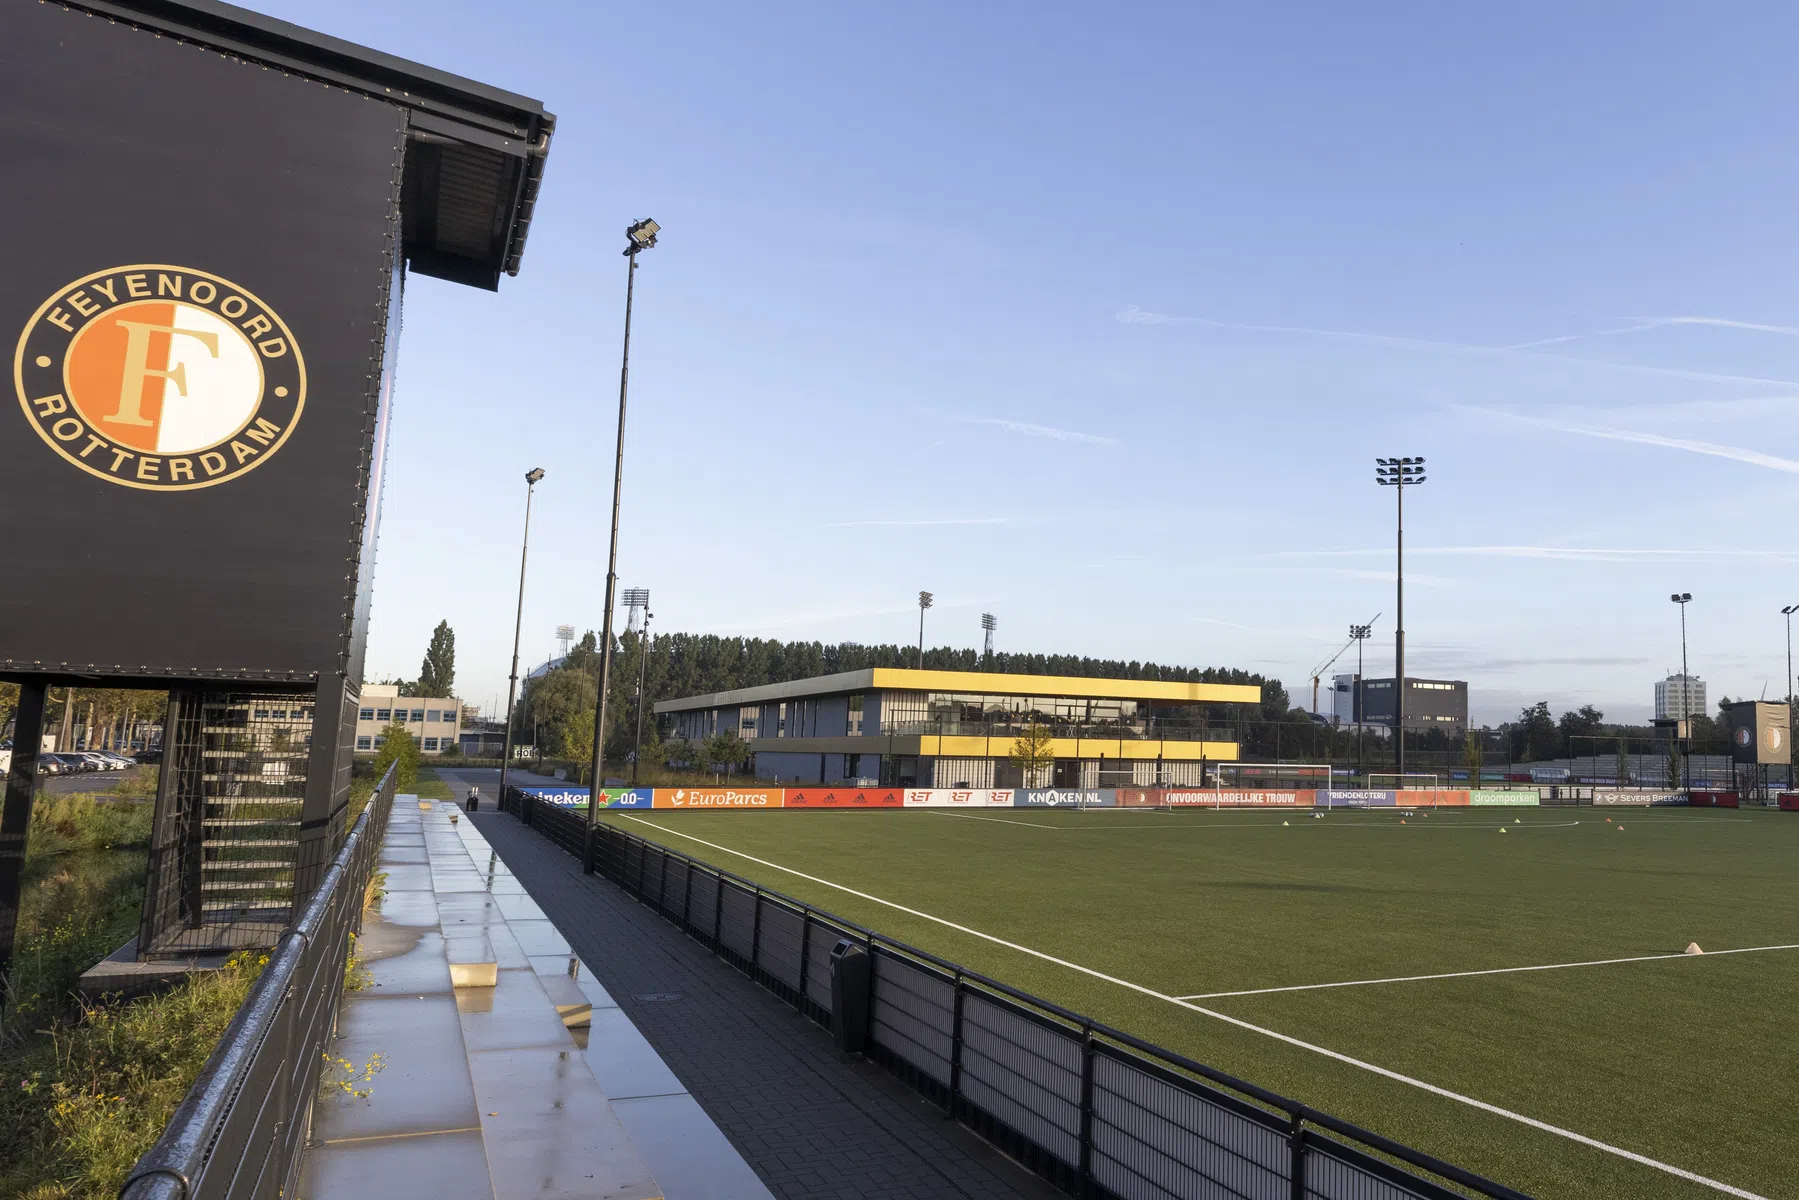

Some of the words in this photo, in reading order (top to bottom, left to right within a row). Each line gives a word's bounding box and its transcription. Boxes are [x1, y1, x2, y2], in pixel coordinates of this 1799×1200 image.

[46, 273, 287, 359] FEYENOORD
[103, 319, 219, 427] F
[34, 393, 282, 481] ROTTERDAM
[689, 791, 768, 805] EuroParcs
[910, 791, 933, 802] RET
[951, 791, 973, 802] RET
[991, 791, 1012, 802] RET
[1028, 790, 1102, 806] KNAKENNL
[1166, 792, 1263, 804] ONVOORWAARDELIJKE
[1266, 792, 1296, 804] TROUW
[1475, 792, 1535, 805] droomparken
